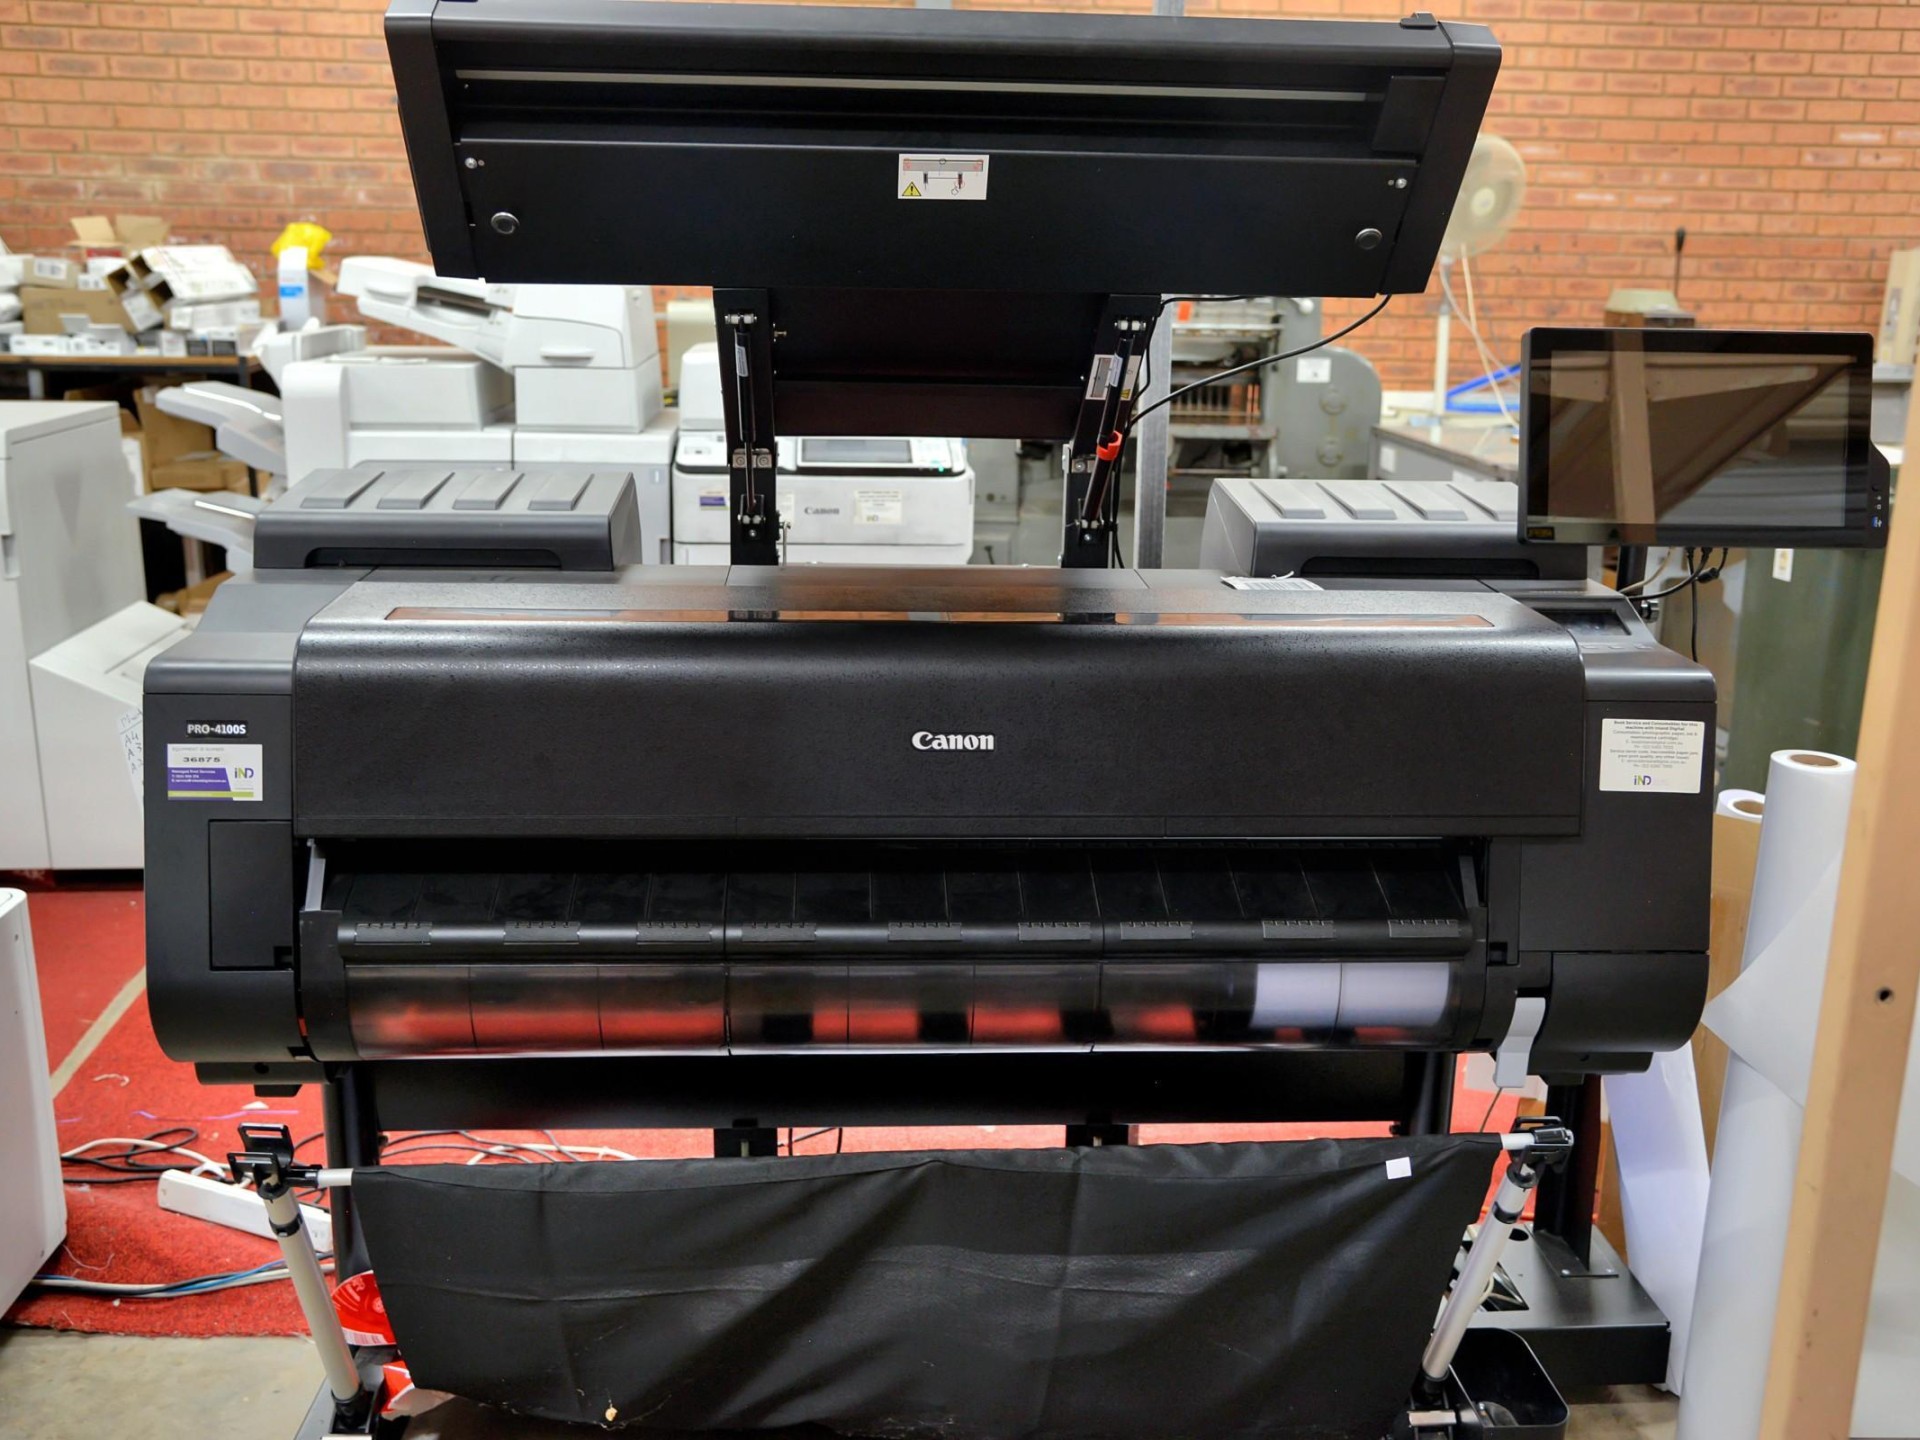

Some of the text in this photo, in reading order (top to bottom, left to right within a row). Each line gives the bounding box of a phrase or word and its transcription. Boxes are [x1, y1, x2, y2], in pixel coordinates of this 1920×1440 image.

[804, 506, 840, 515] Canon
[187, 724, 247, 735] PRO-4100S
[911, 731, 995, 750] Canon
